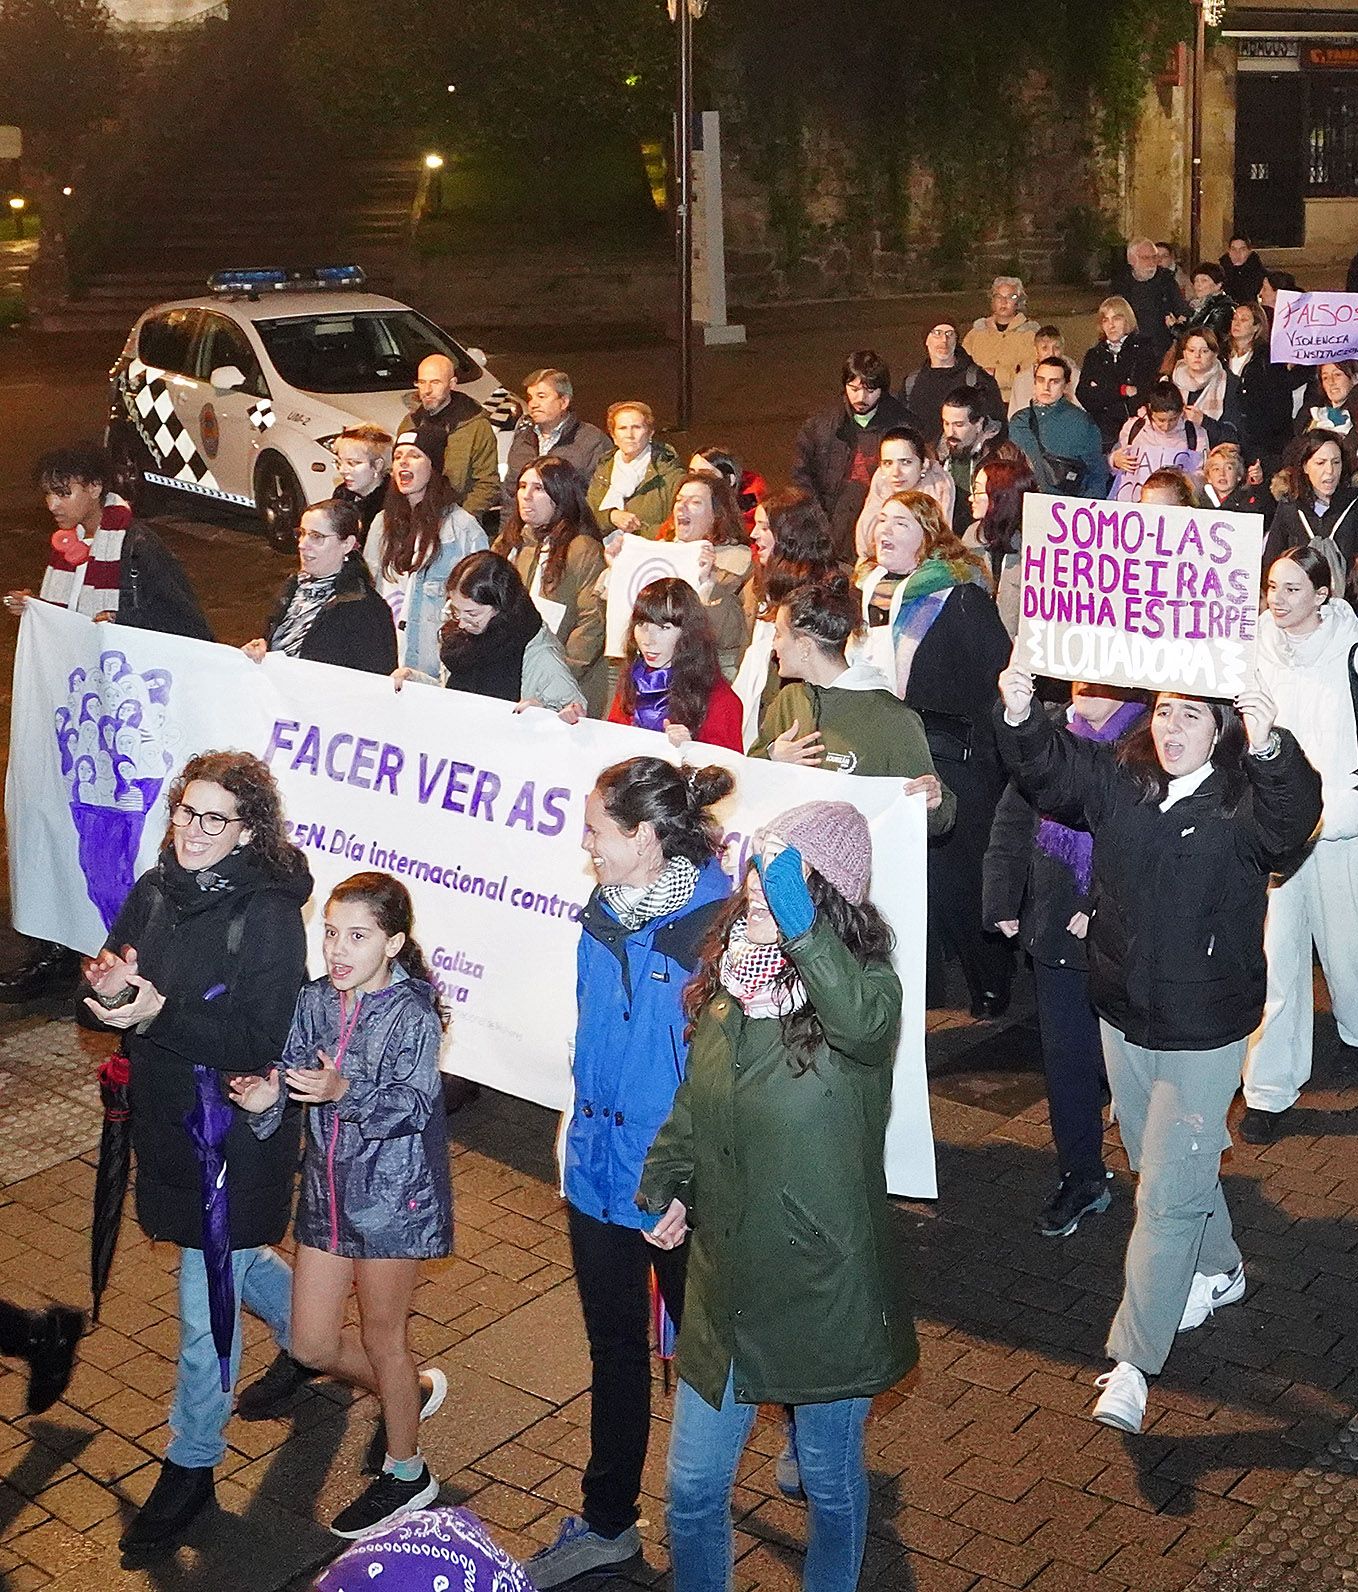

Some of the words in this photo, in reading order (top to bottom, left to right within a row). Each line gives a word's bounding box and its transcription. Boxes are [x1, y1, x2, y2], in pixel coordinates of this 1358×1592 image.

[1286, 330, 1349, 346] VIOLENCIA
[1047, 501, 1235, 564] SÓMO-LAS
[1024, 545, 1250, 604] HERDEIRAS
[1023, 585, 1117, 627] DUNHA
[1124, 596, 1257, 640] ESTIRPE
[262, 719, 405, 796] FACER
[418, 753, 501, 822] VER
[504, 780, 571, 837] AS
[368, 841, 508, 902] internacional
[510, 886, 583, 924] contra
[431, 946, 485, 979] Galiza
[436, 972, 470, 1003] ova
